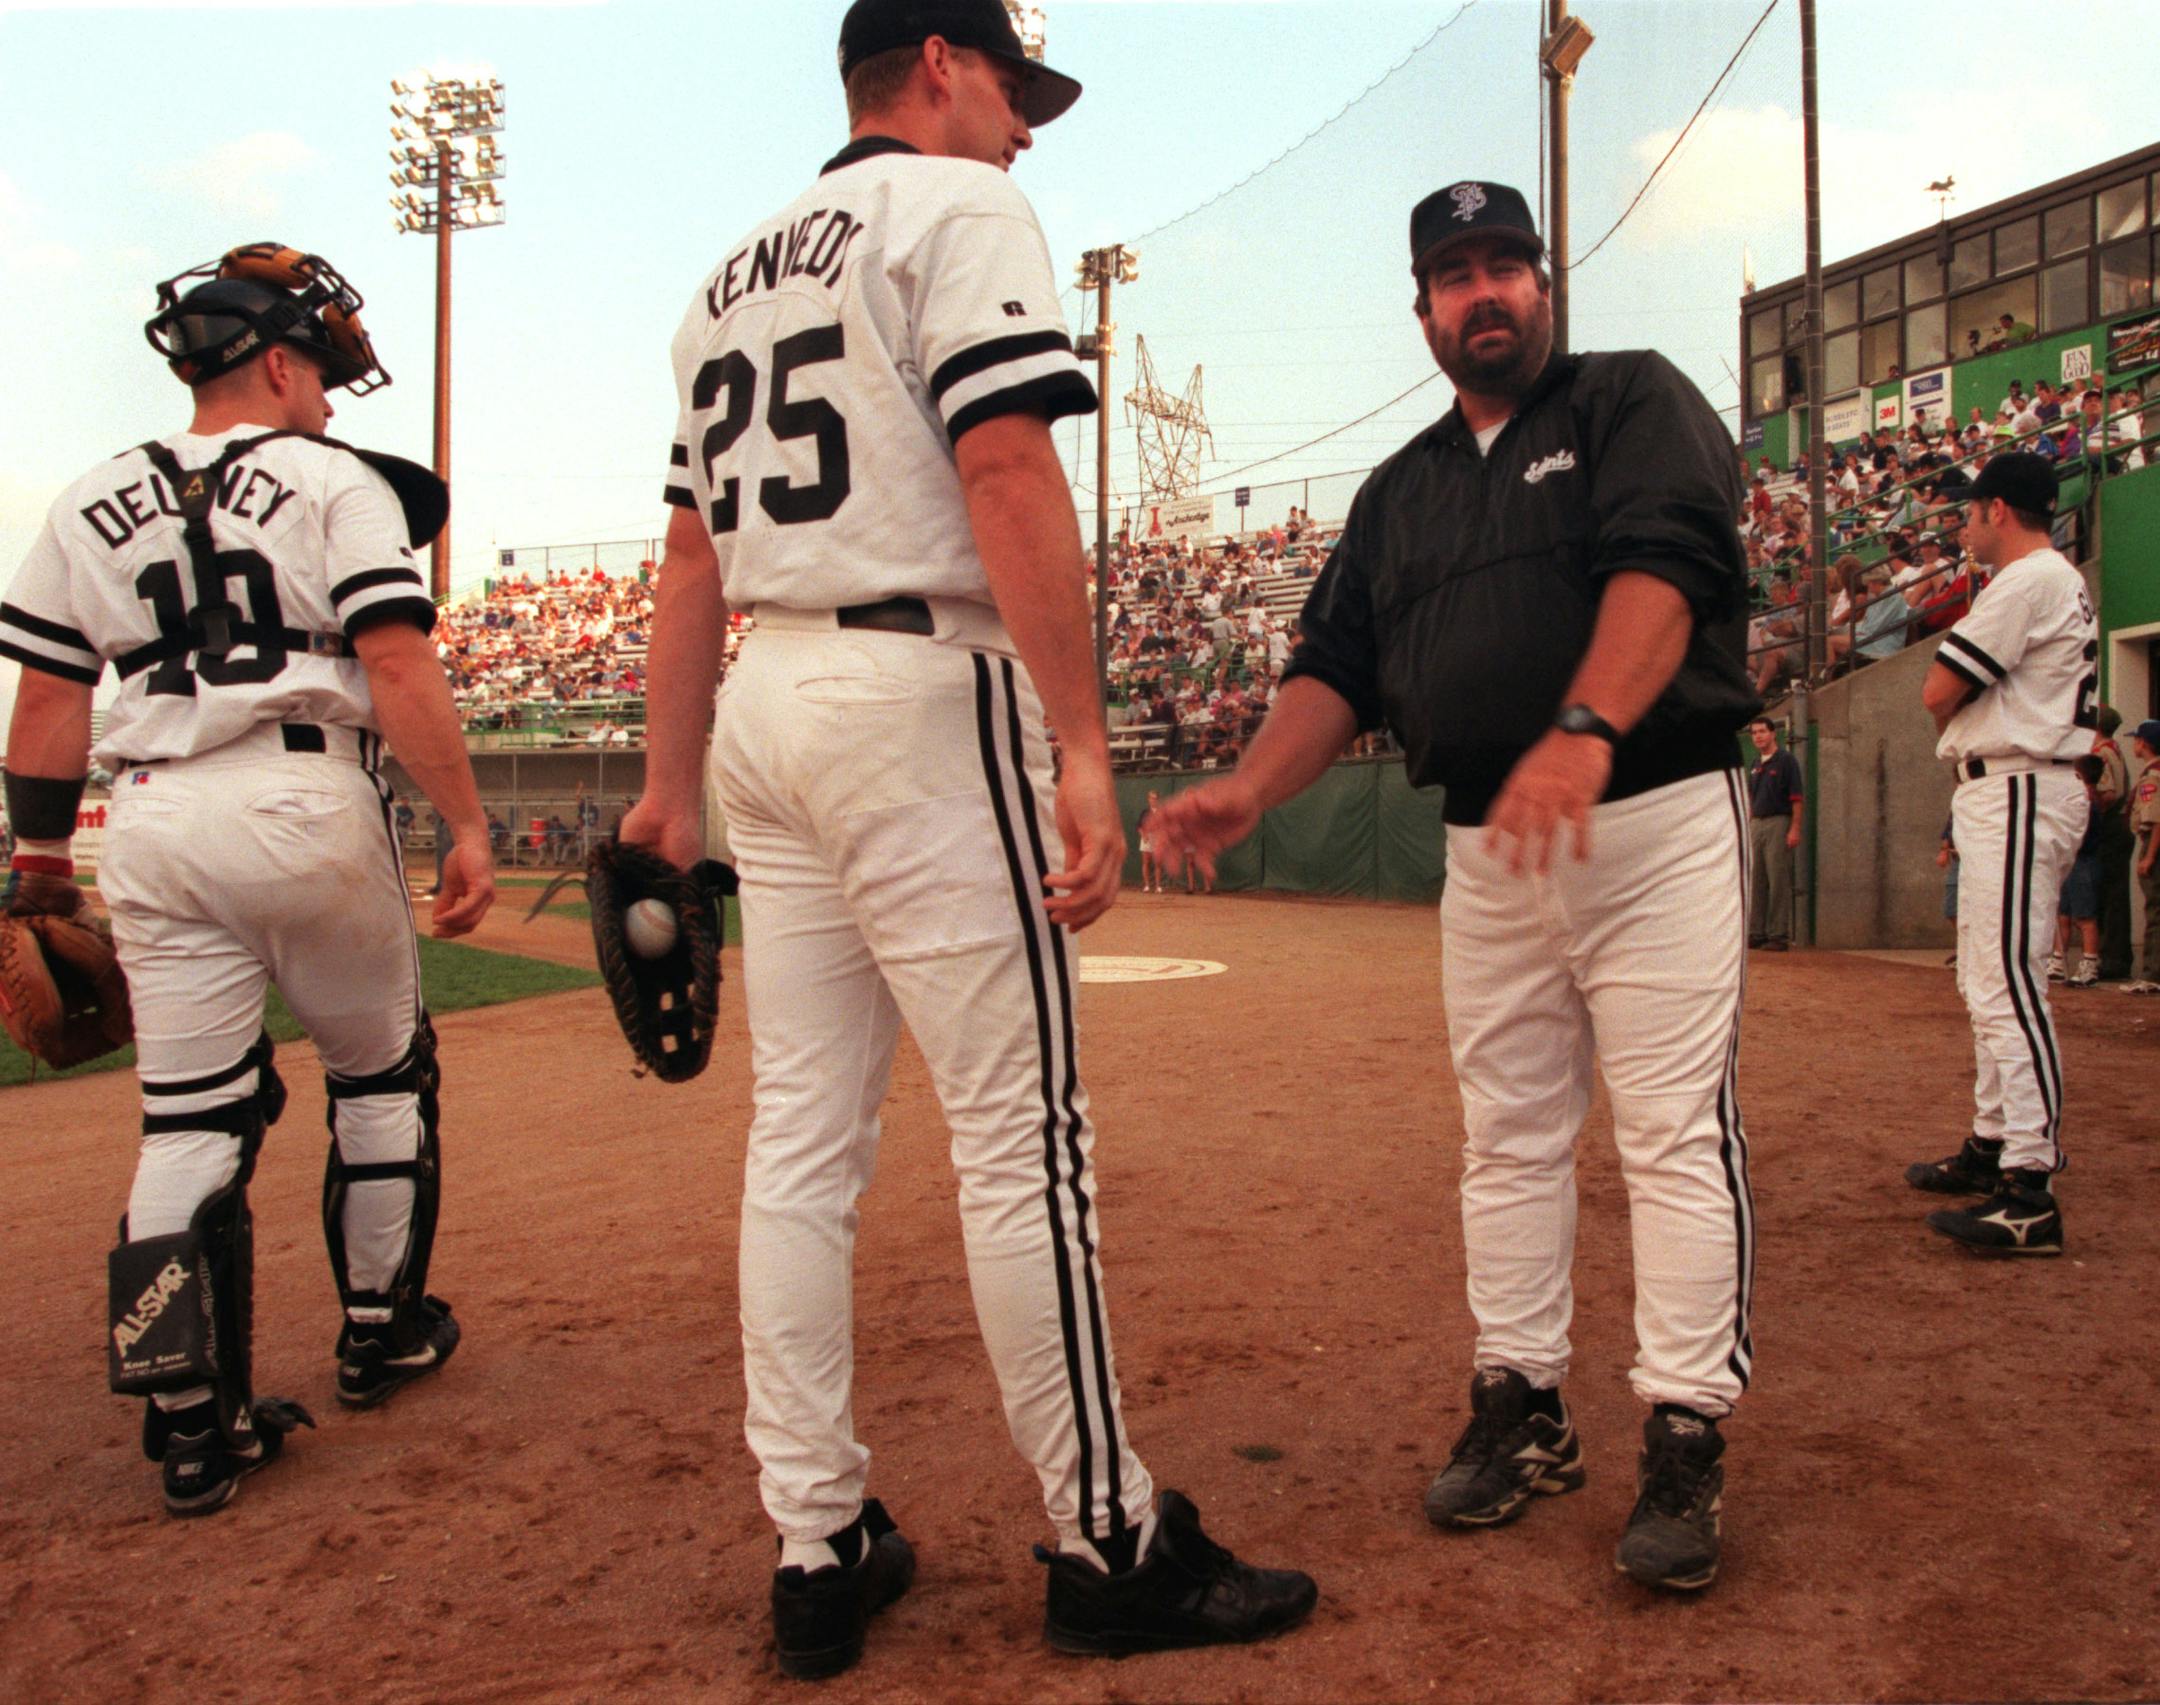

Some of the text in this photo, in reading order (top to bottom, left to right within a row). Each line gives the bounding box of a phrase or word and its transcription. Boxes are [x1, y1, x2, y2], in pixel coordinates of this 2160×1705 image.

[692, 322, 851, 536] 25
[1879, 406, 1896, 420] 3M
[1523, 449, 1576, 483] Saints
[80, 465, 297, 550] DELNEY
[113, 1262, 192, 1358] ALL-STAR
[122, 1360, 152, 1372] Knee
[156, 1352, 187, 1364] Saver
